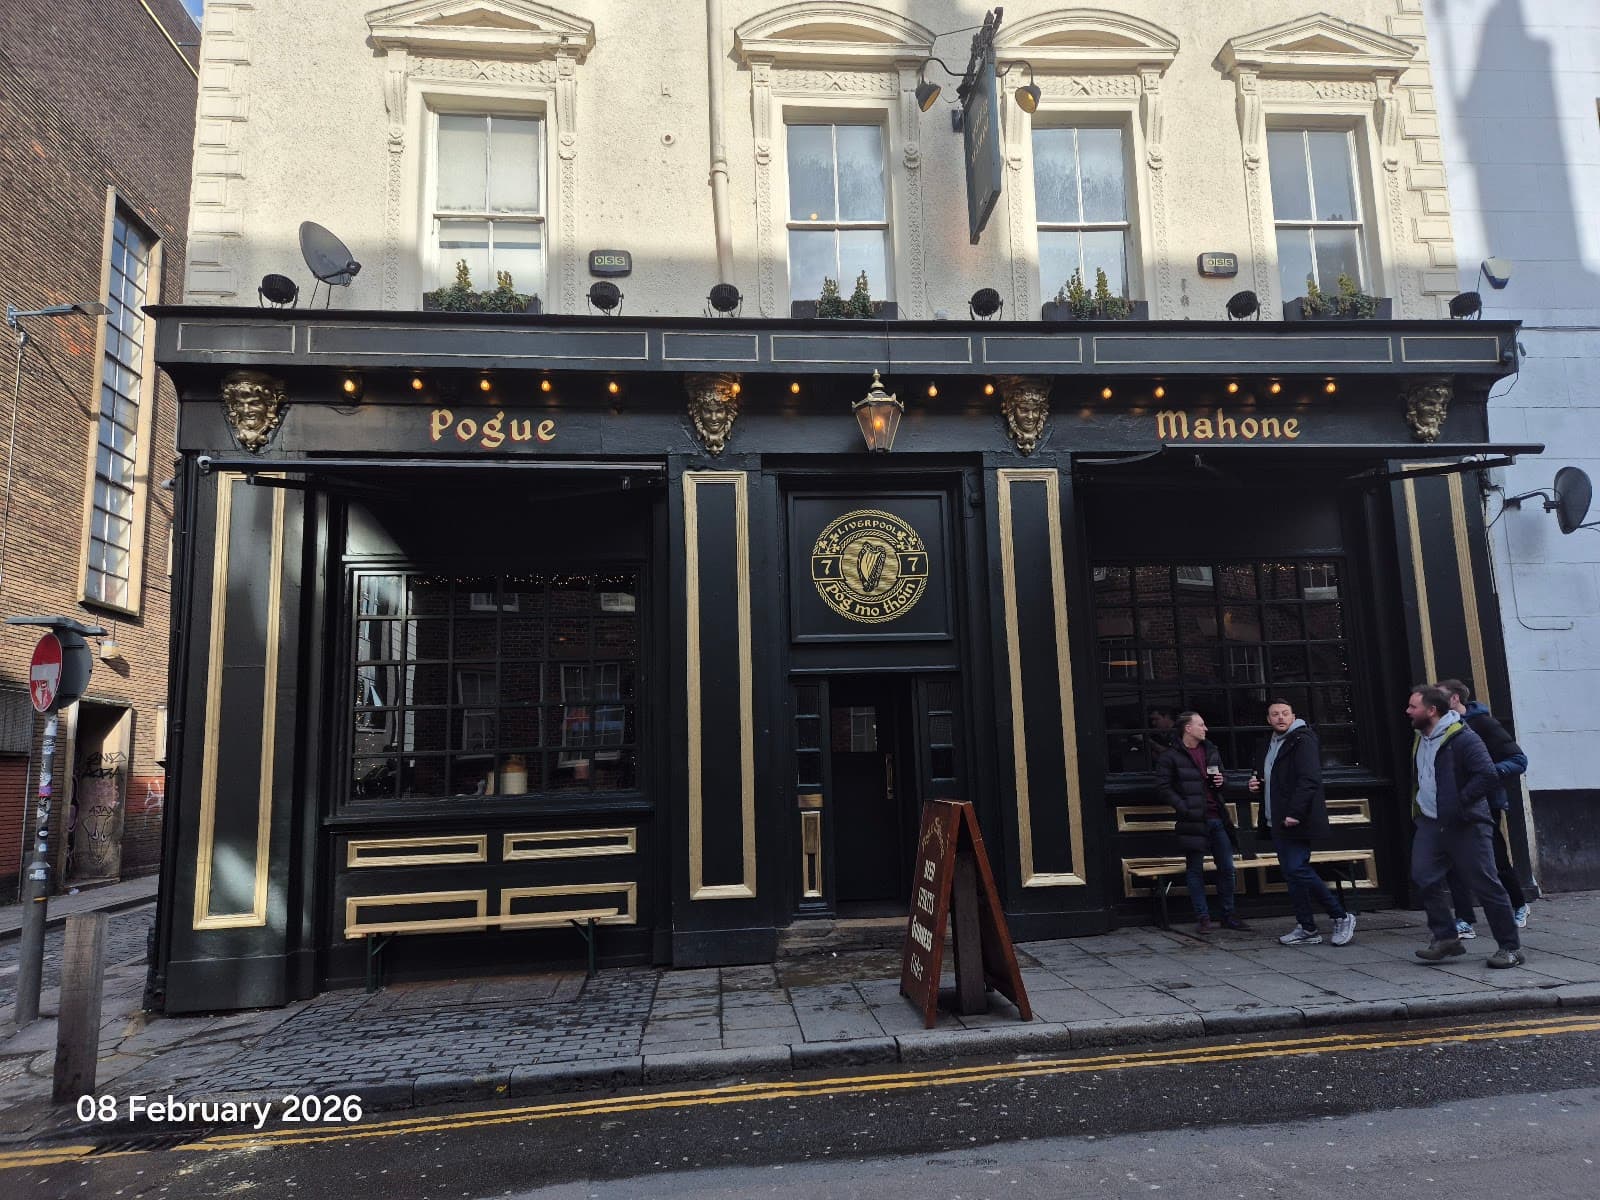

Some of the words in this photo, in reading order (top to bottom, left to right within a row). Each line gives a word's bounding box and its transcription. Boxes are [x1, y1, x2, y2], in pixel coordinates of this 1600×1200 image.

[429, 409, 556, 449] Pogue
[1156, 408, 1300, 439] Mahone
[838, 520, 898, 535] LIVERPOOL
[821, 560, 832, 575] 7
[908, 557, 919, 572] 7
[854, 604, 880, 616] mo
